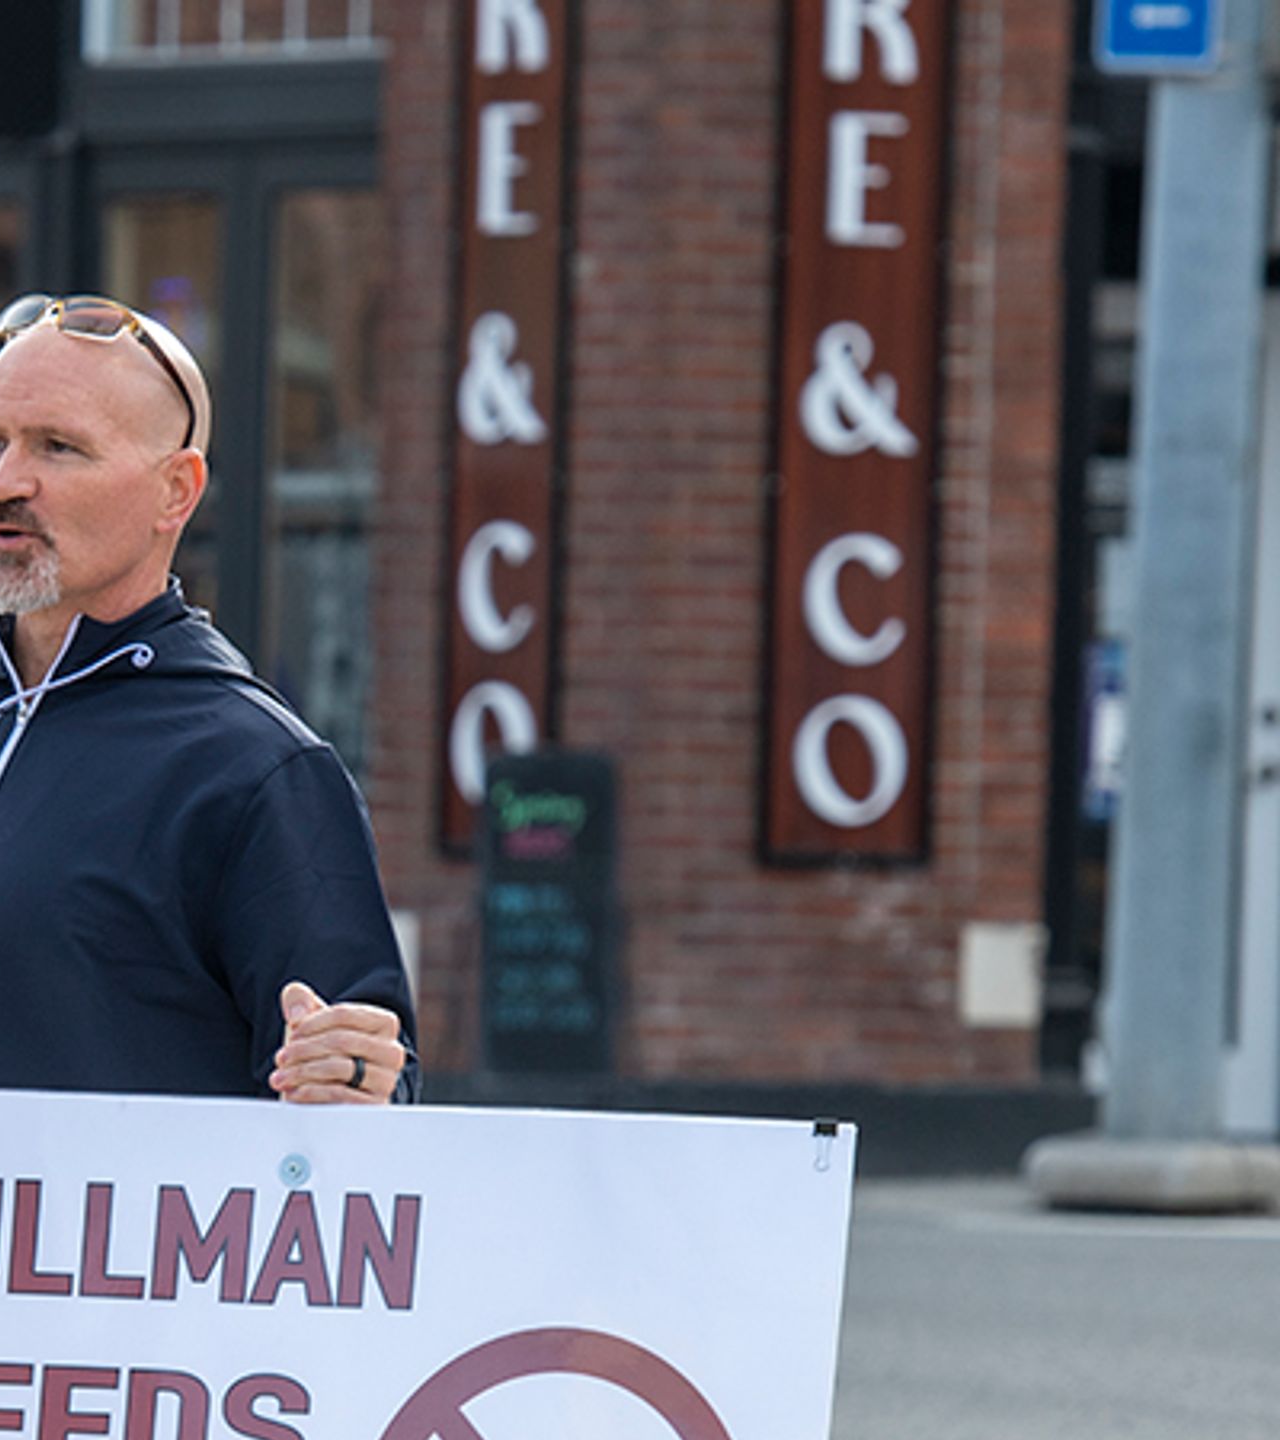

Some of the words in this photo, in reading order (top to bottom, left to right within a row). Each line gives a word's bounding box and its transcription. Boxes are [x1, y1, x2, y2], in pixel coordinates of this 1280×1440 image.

[457, 311, 546, 446] &
[800, 321, 919, 458] &
[792, 532, 908, 829] CO
